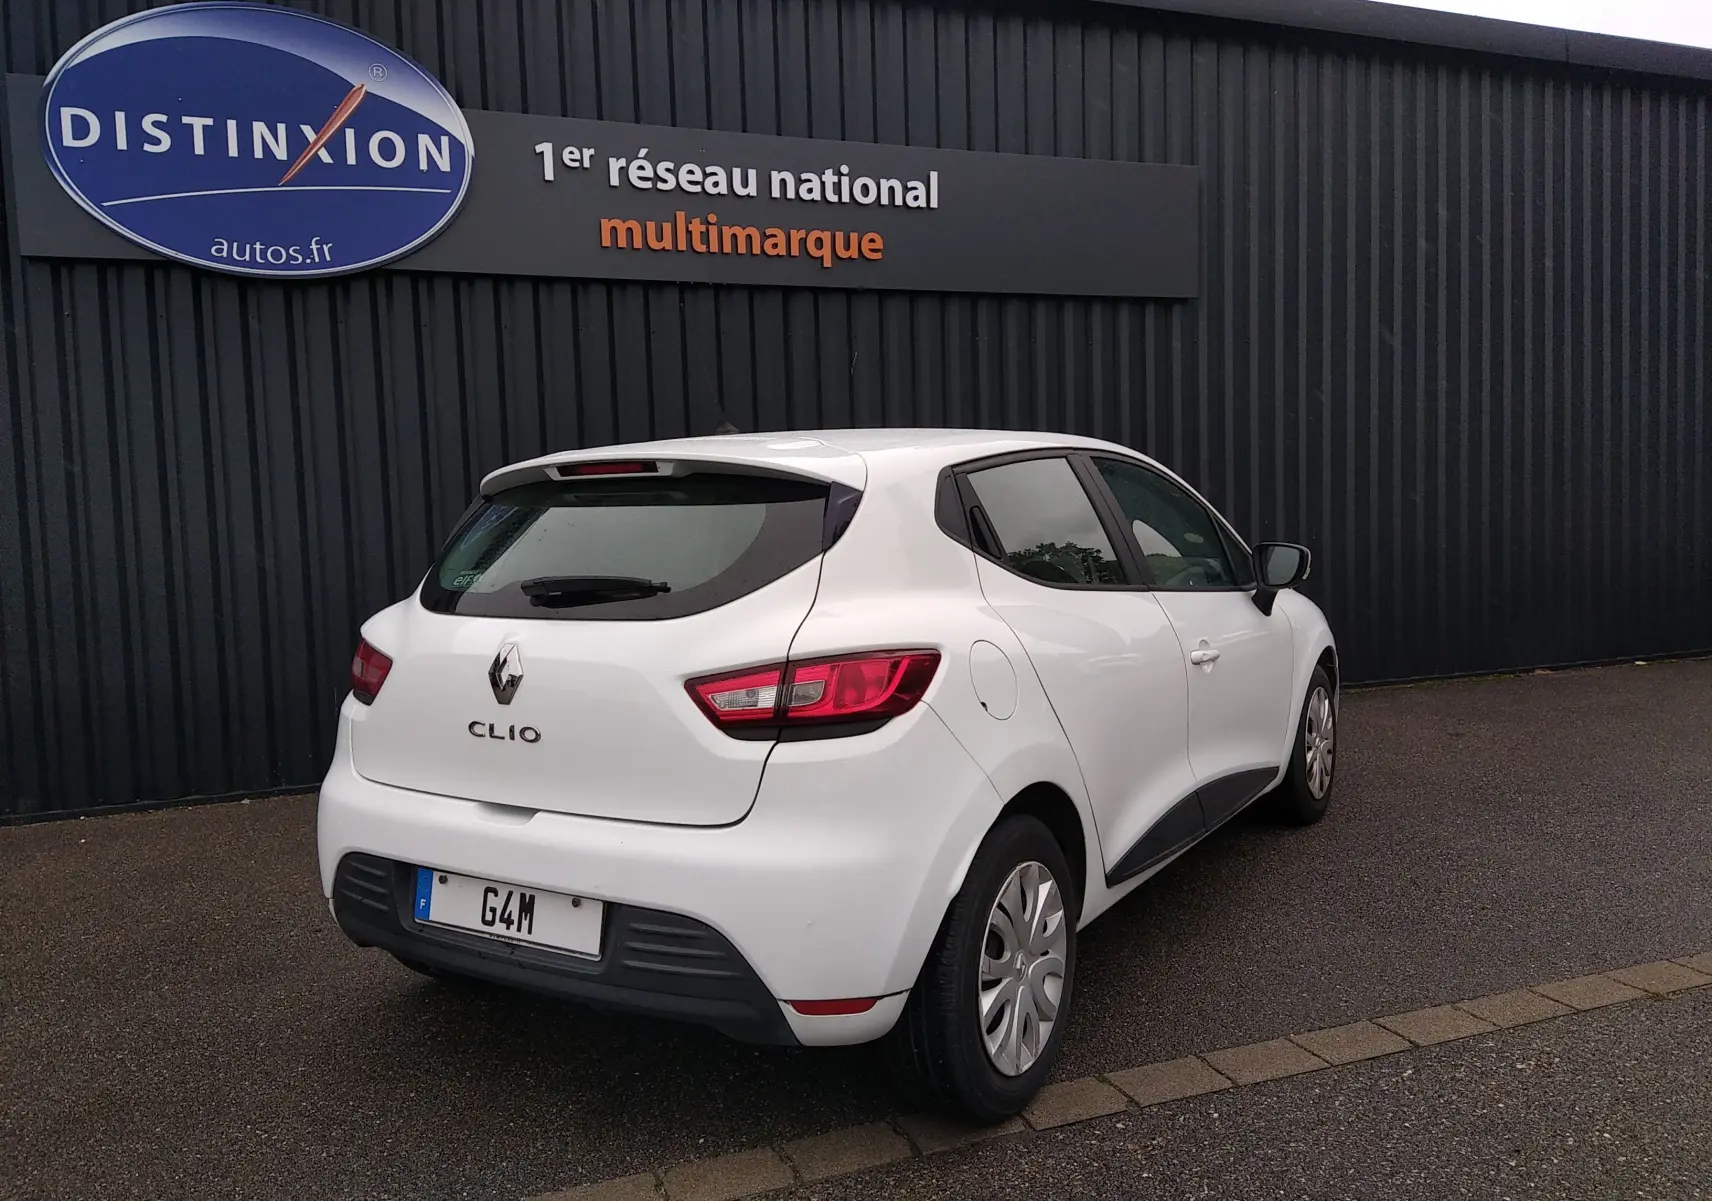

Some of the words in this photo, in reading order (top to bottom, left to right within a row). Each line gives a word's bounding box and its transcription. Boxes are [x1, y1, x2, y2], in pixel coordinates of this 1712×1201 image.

[60, 106, 451, 172] DISTINXION
[534, 141, 595, 182] 1er
[608, 148, 757, 197] réseau
[770, 165, 939, 209] national
[210, 236, 333, 265] autos.fr
[600, 210, 884, 267] multimarque
[468, 720, 541, 743] CLIO
[420, 899, 426, 909] F
[481, 886, 535, 935] G4M
